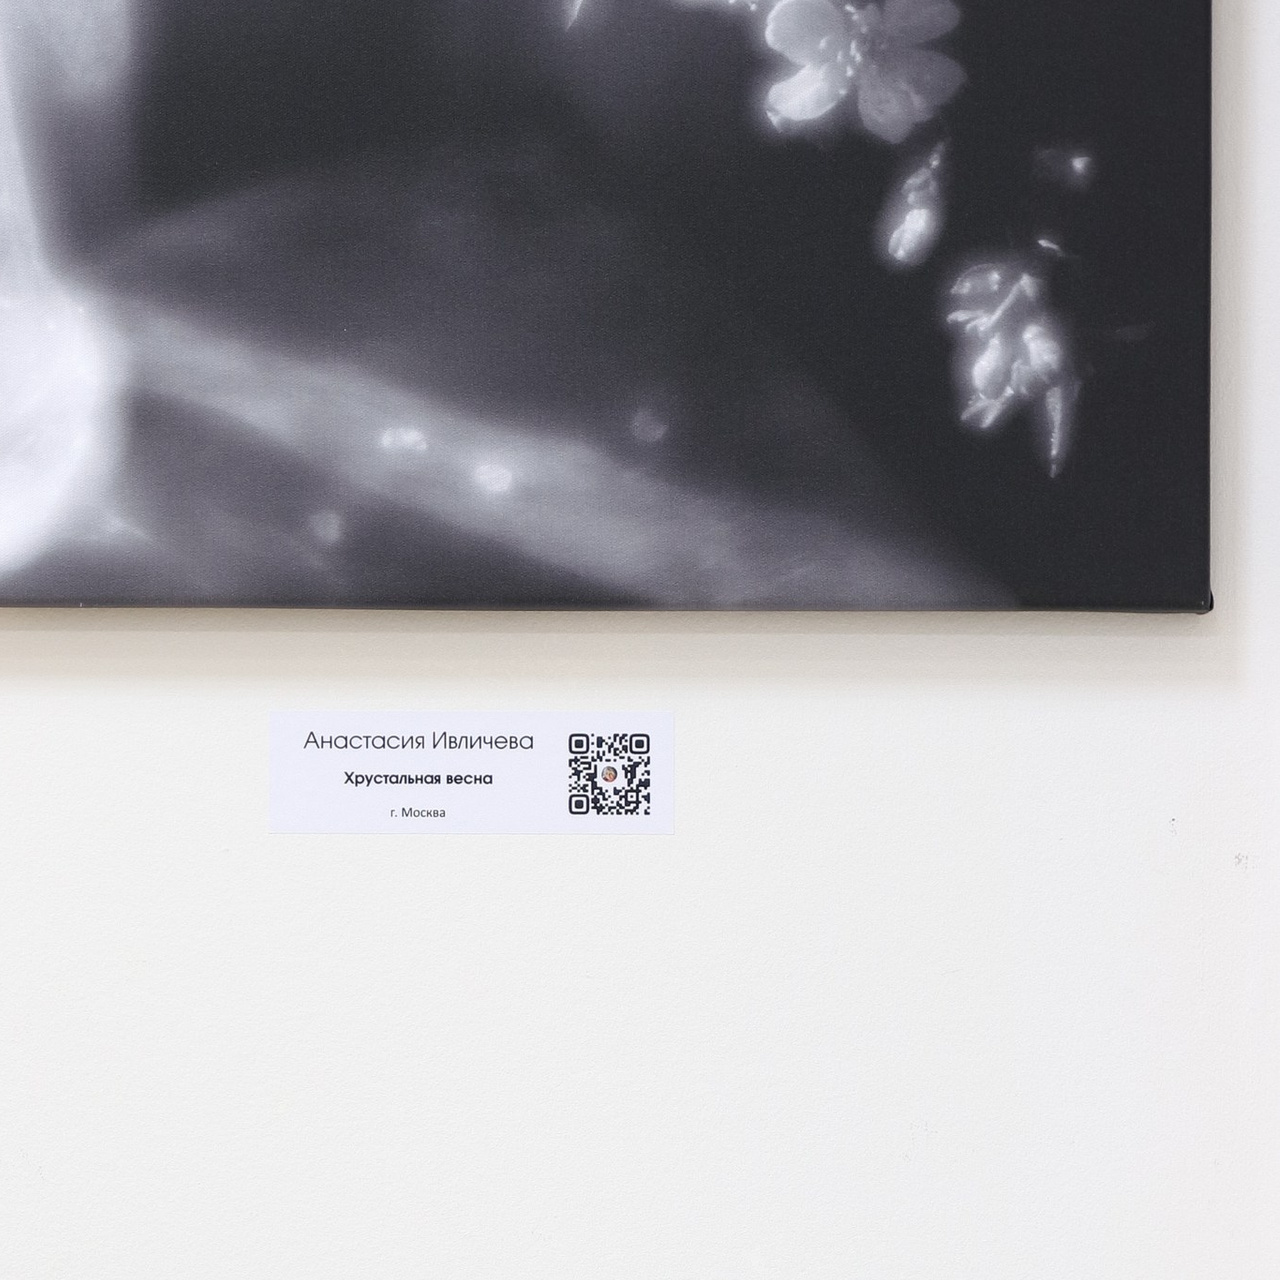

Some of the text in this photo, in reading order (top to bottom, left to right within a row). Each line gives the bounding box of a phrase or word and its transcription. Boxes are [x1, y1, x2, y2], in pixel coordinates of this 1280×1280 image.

[303, 730, 534, 750] Анастасия Ивличева
[343, 771, 494, 788] Хрустальная весна
[390, 806, 446, 818] г. Москва
